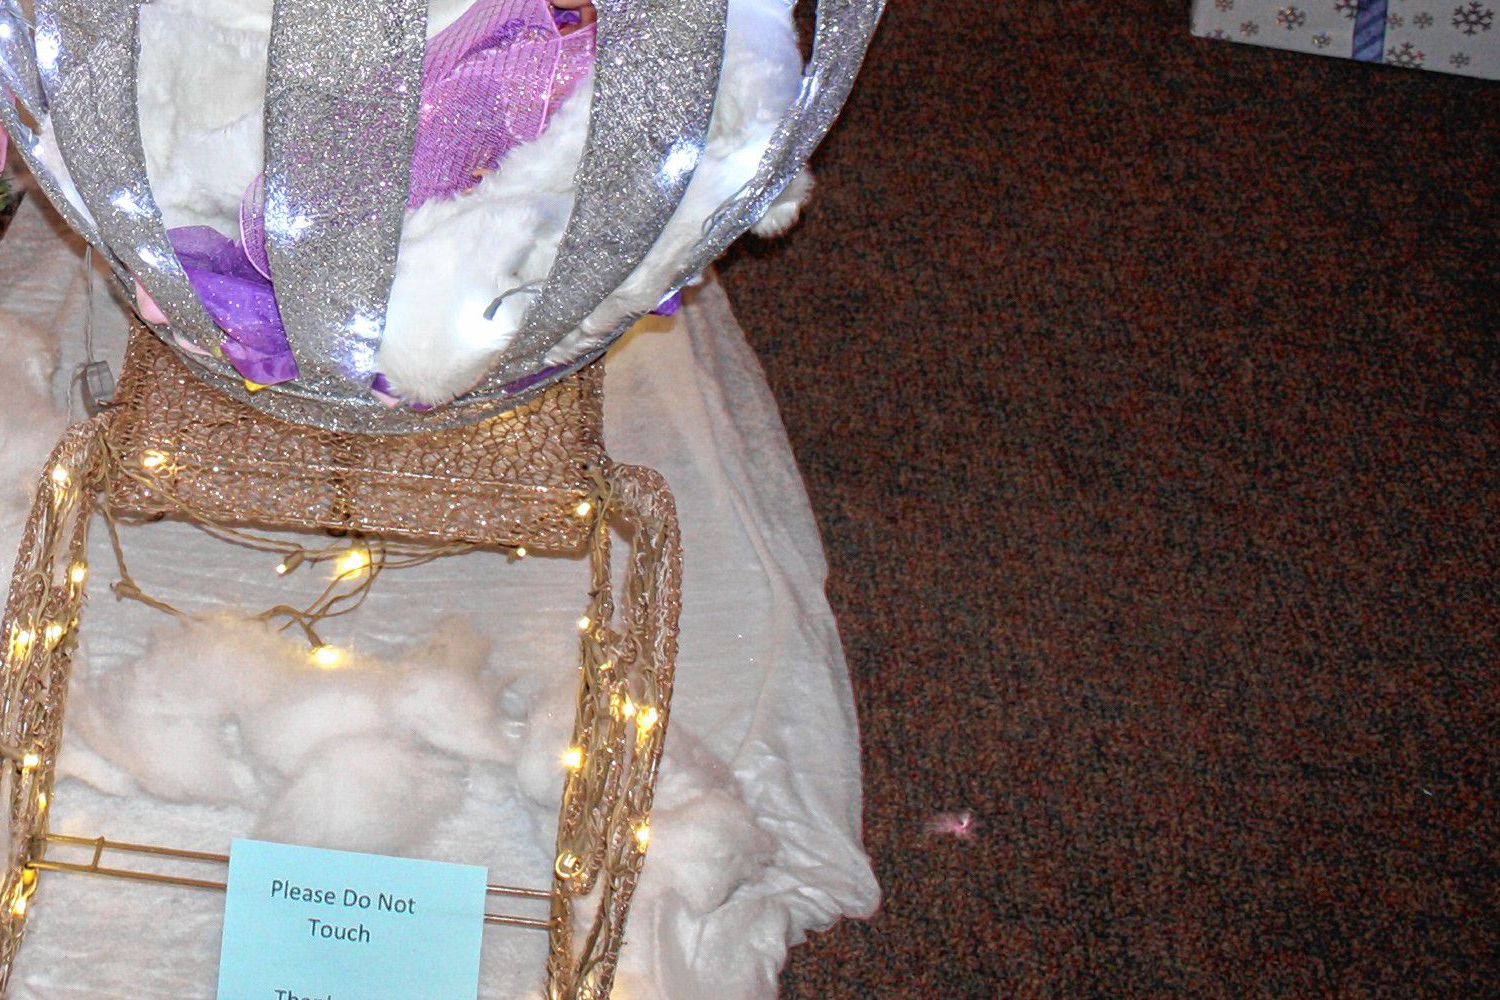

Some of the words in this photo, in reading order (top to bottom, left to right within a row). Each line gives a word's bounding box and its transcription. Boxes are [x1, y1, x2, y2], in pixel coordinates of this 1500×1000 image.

[271, 879, 336, 904] Please
[342, 888, 372, 910] Do
[377, 893, 416, 914] Not
[308, 918, 371, 943] Touch
